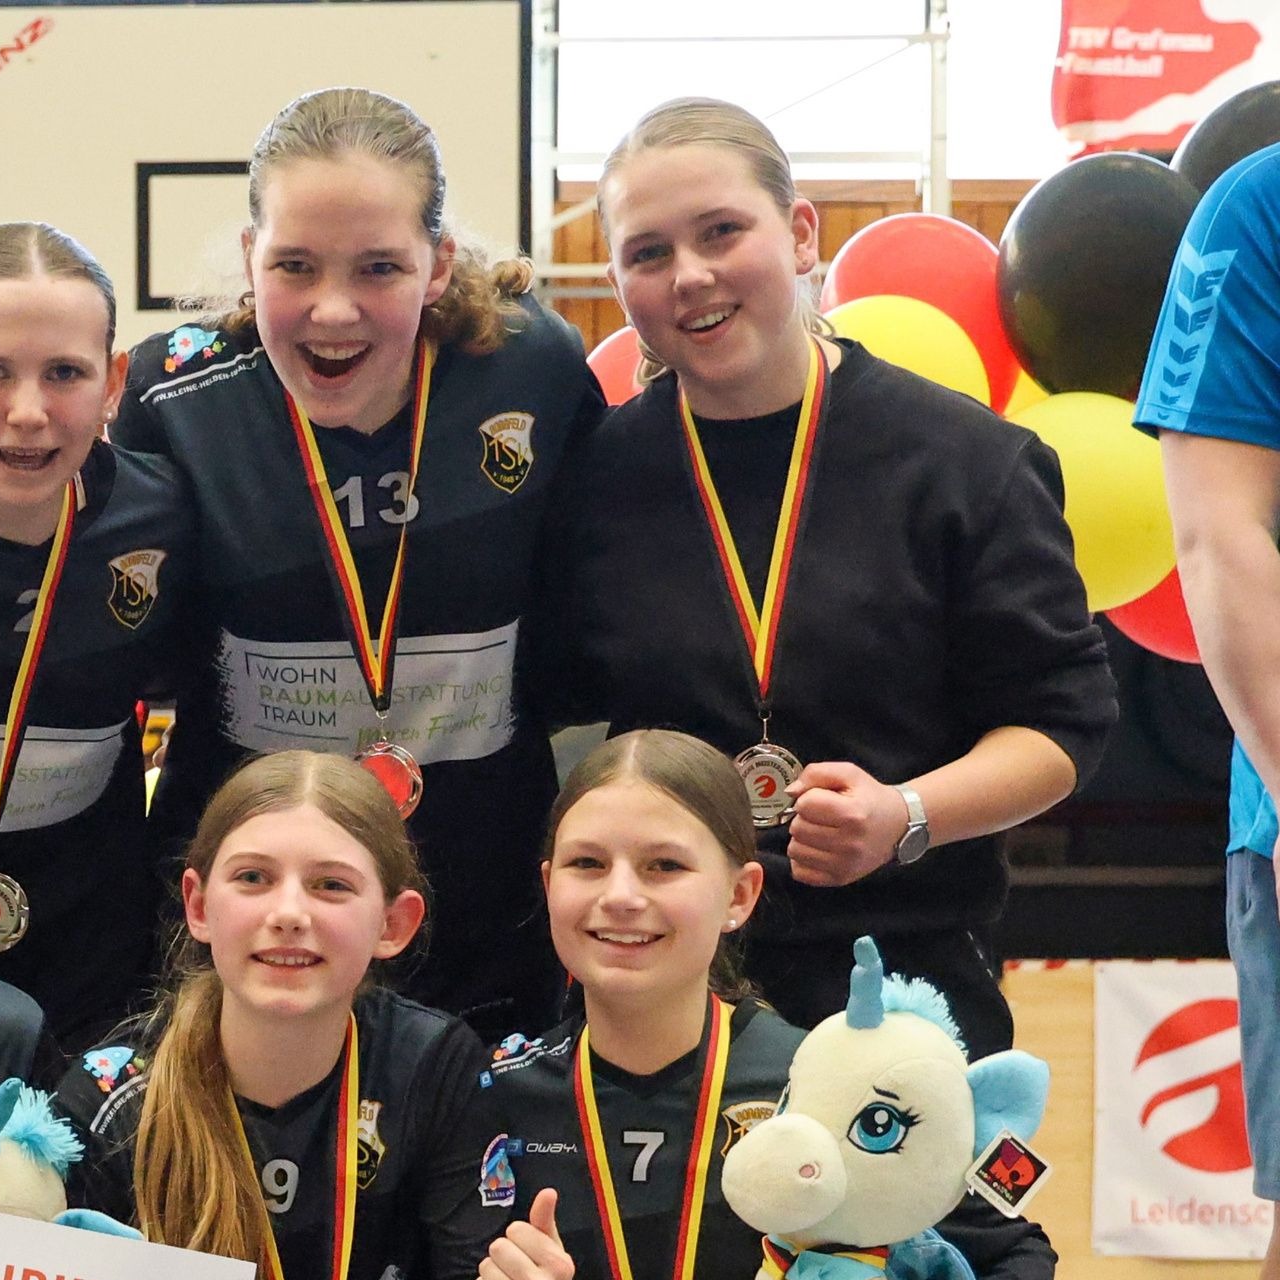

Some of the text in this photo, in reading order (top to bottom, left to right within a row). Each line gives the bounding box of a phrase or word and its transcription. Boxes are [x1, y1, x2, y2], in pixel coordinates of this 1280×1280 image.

[1069, 26, 1110, 49] TSV
[334, 471, 420, 528] 13
[256, 663, 336, 685] WOHN
[260, 703, 336, 728] TRAUM
[623, 1131, 665, 1182] 7
[261, 1158, 299, 1213] 9
[1130, 1197, 1269, 1225] Leidensc
